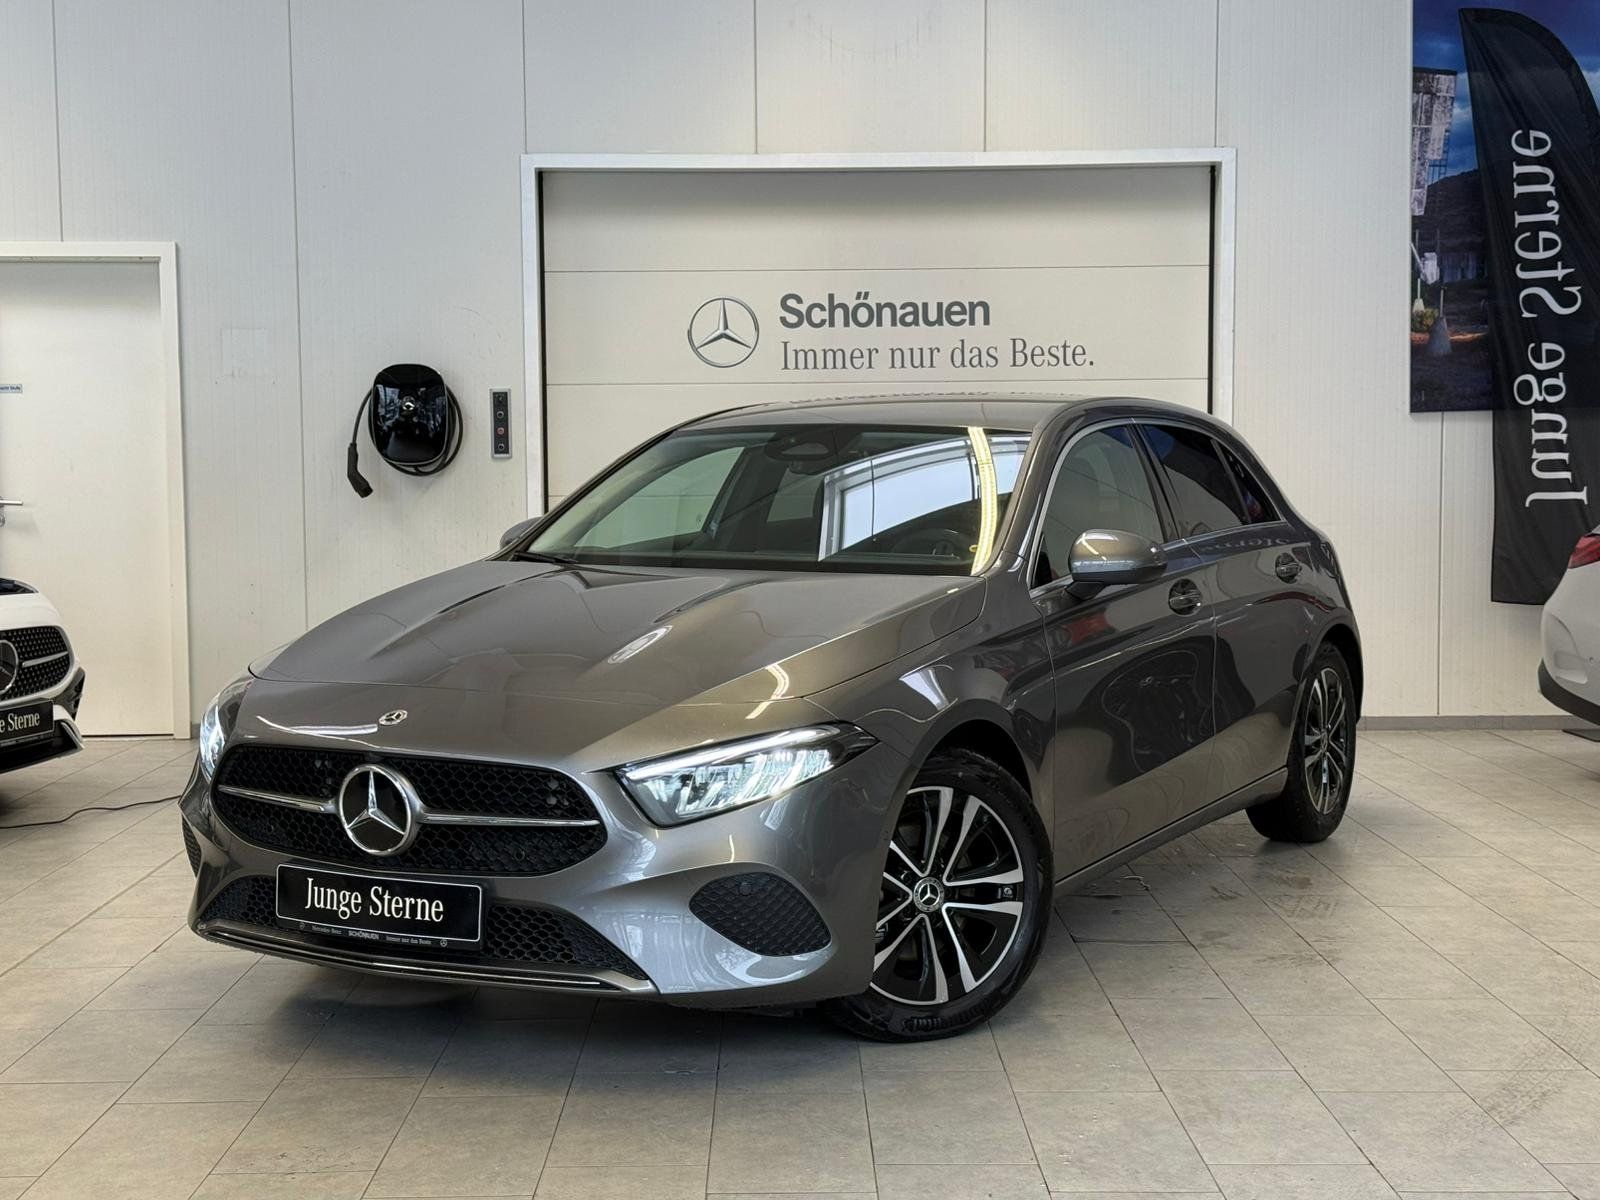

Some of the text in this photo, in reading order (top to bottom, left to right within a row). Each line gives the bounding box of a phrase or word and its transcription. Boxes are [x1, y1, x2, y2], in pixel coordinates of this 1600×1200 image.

[779, 291, 991, 329] Schönauen
[781, 337, 1095, 371] Immer nur das Beste.
[7, 712, 40, 731] Sterne
[305, 877, 444, 923] Junge Sterne
